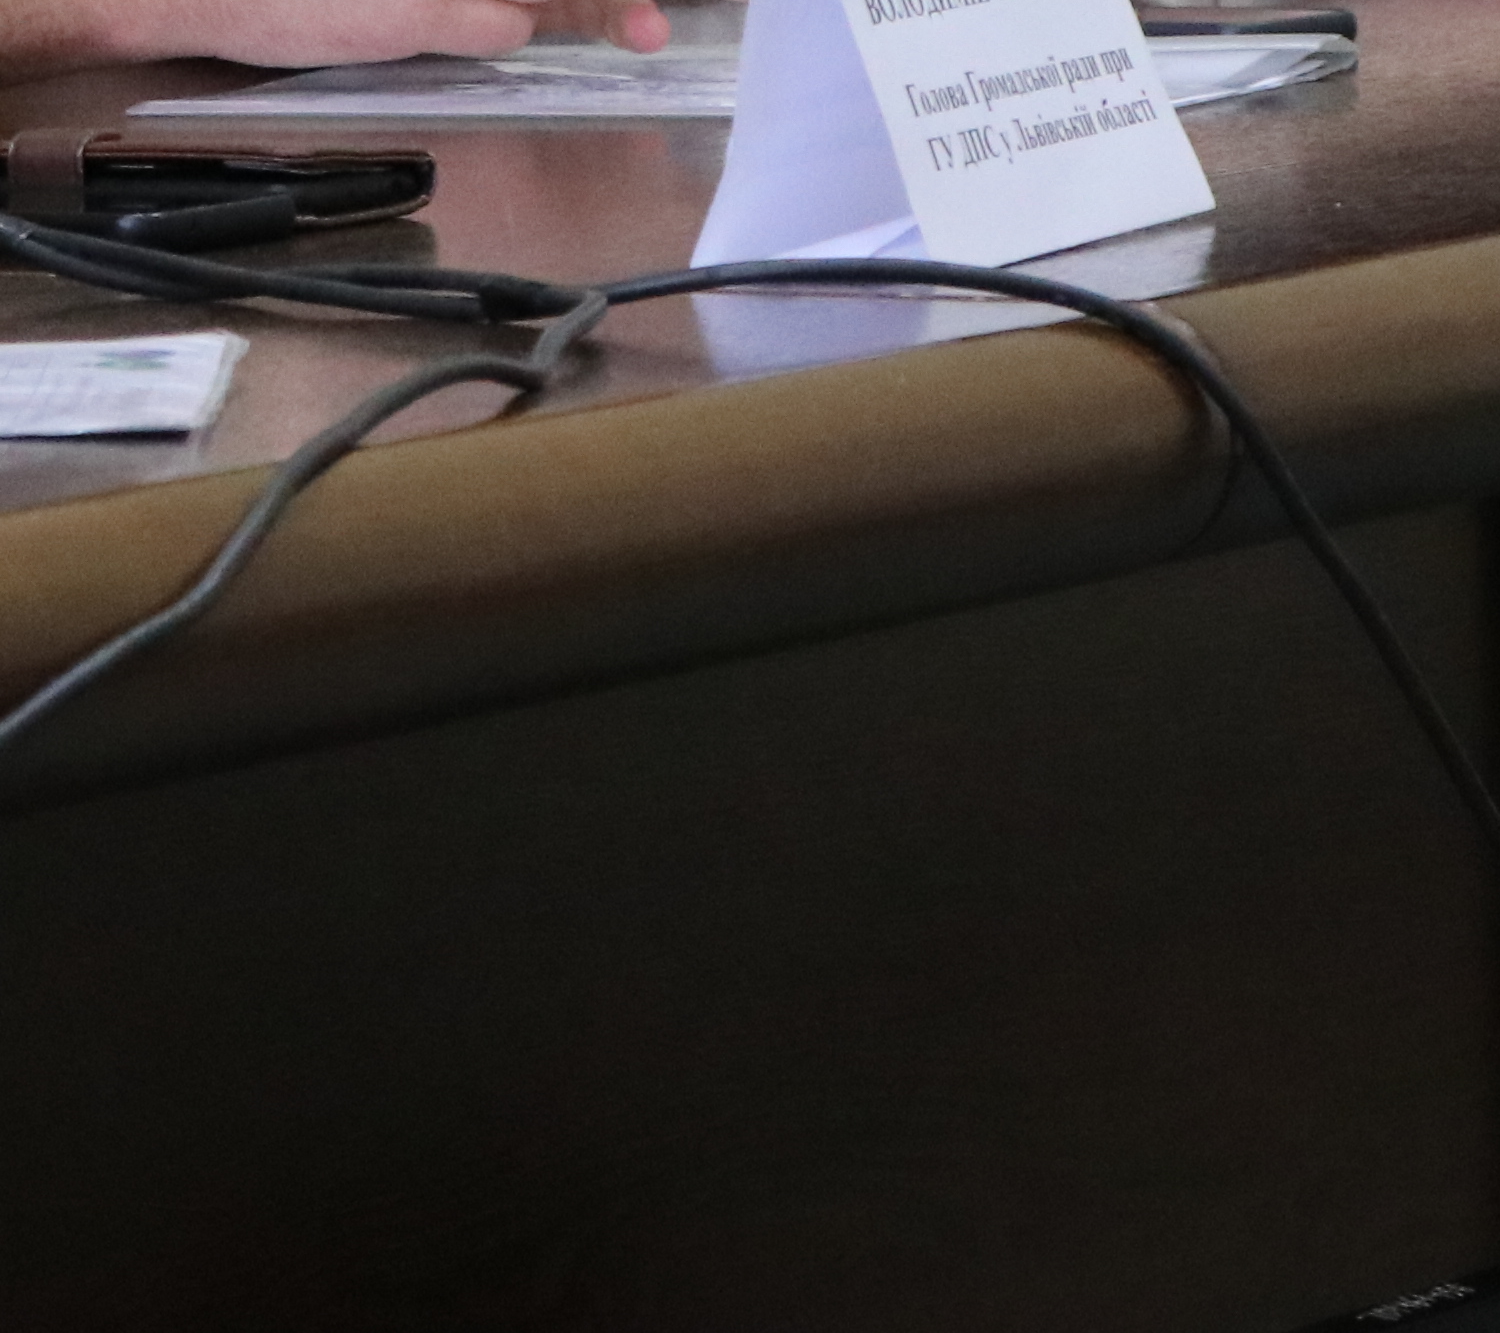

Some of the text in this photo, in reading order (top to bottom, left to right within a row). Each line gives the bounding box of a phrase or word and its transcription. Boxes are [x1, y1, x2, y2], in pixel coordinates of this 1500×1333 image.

[905, 48, 1134, 117] Голова Громадської ради при
[927, 90, 1158, 171] ГУ ДПС у Львівській області
